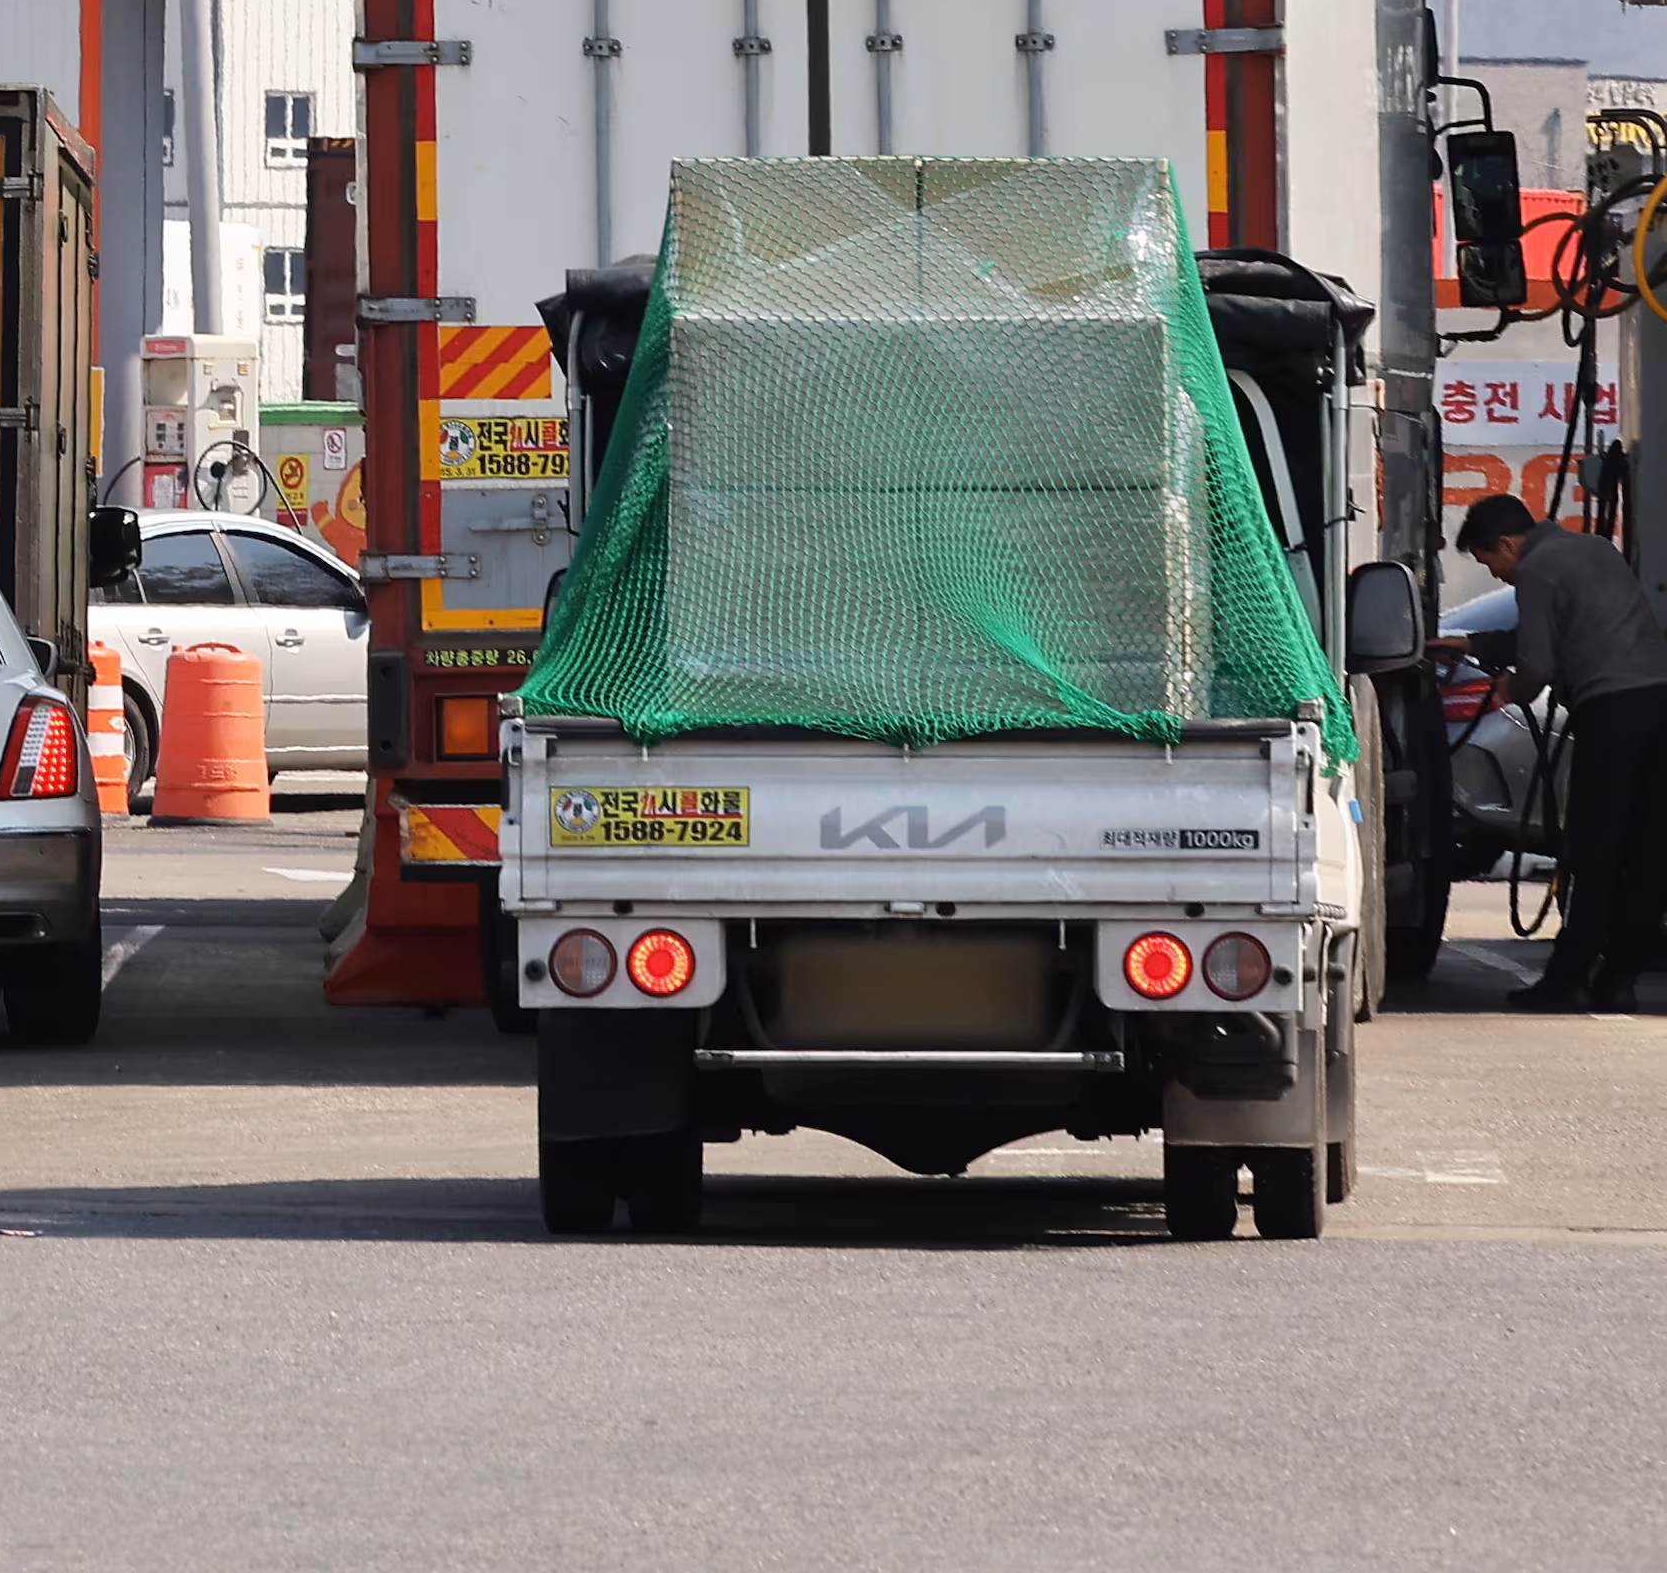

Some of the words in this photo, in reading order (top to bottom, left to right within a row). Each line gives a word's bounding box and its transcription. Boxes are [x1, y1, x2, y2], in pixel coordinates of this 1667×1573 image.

[1441, 380, 1520, 424] 충전
[477, 453, 569, 476] 1588-79
[600, 820, 742, 842] 1588-7924
[1184, 830, 1254, 850] 1000kg
